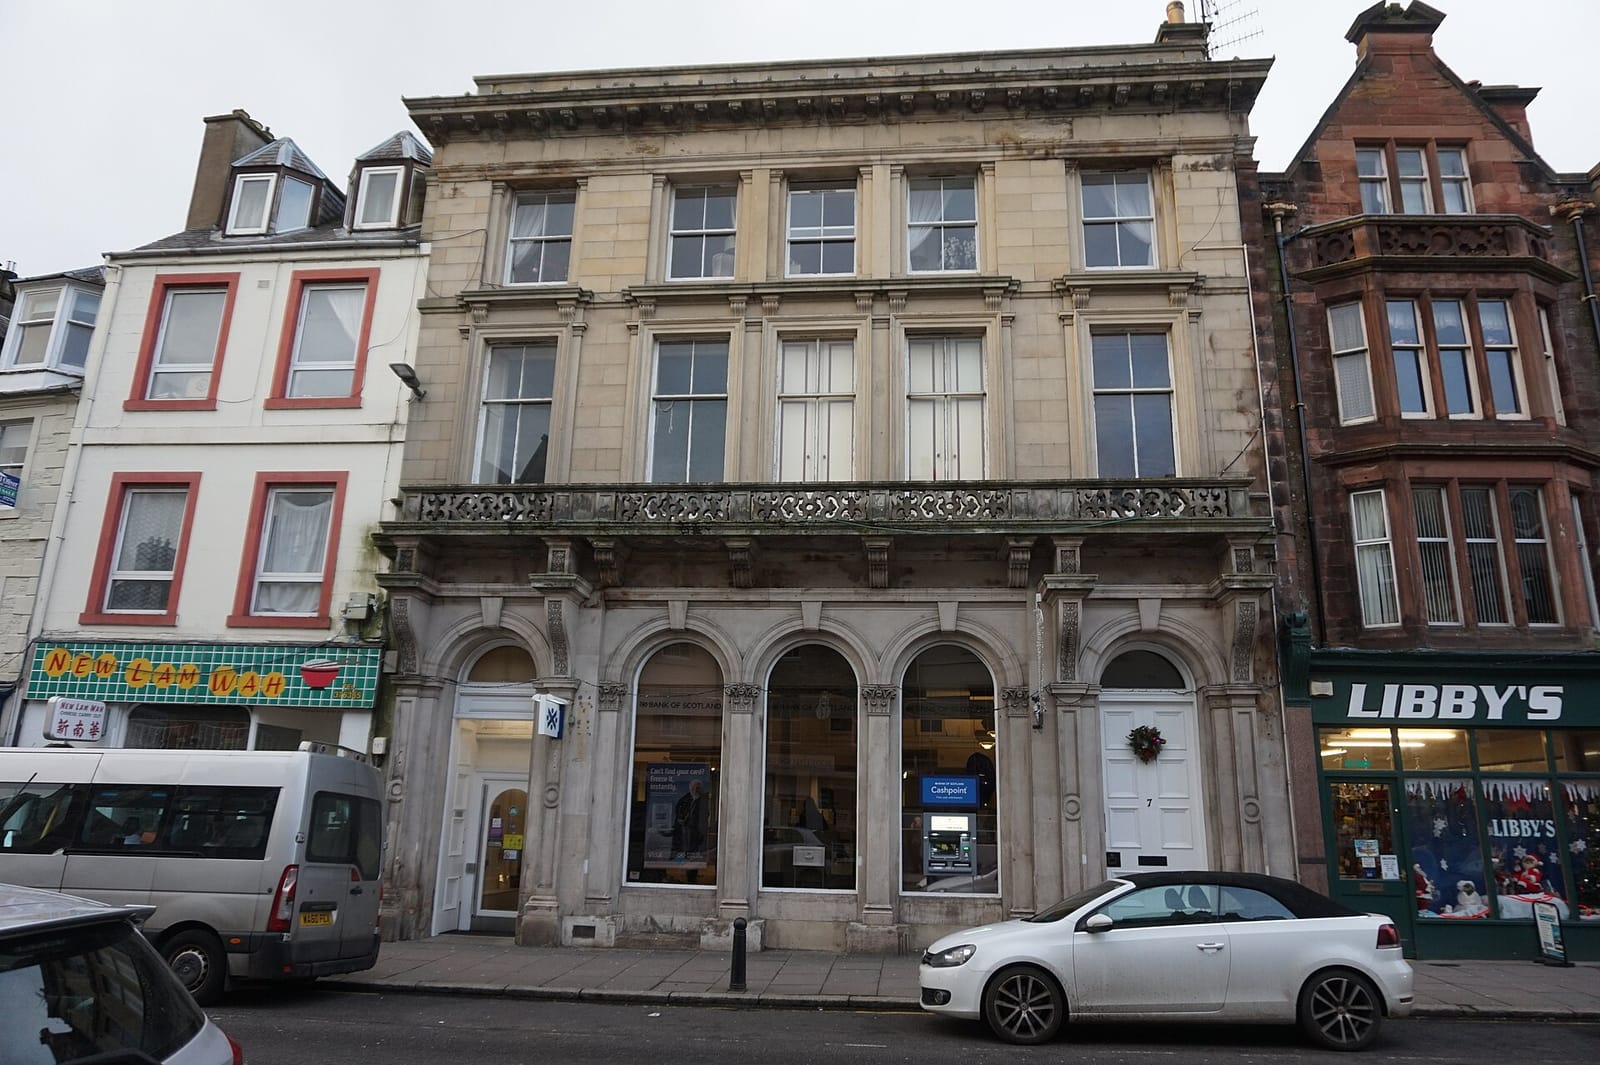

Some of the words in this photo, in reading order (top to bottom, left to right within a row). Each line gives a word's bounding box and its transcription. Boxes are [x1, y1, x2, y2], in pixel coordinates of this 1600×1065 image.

[47, 652, 115, 674] NEW
[130, 663, 196, 684] LAM
[211, 673, 282, 695] WAH
[683, 702, 721, 710] SCOTLAND
[1347, 683, 1564, 720] LIBBY'S
[931, 786, 967, 796] Cashpoint
[1146, 798, 1153, 808] 7
[1491, 819, 1556, 838] LIBBY'S
